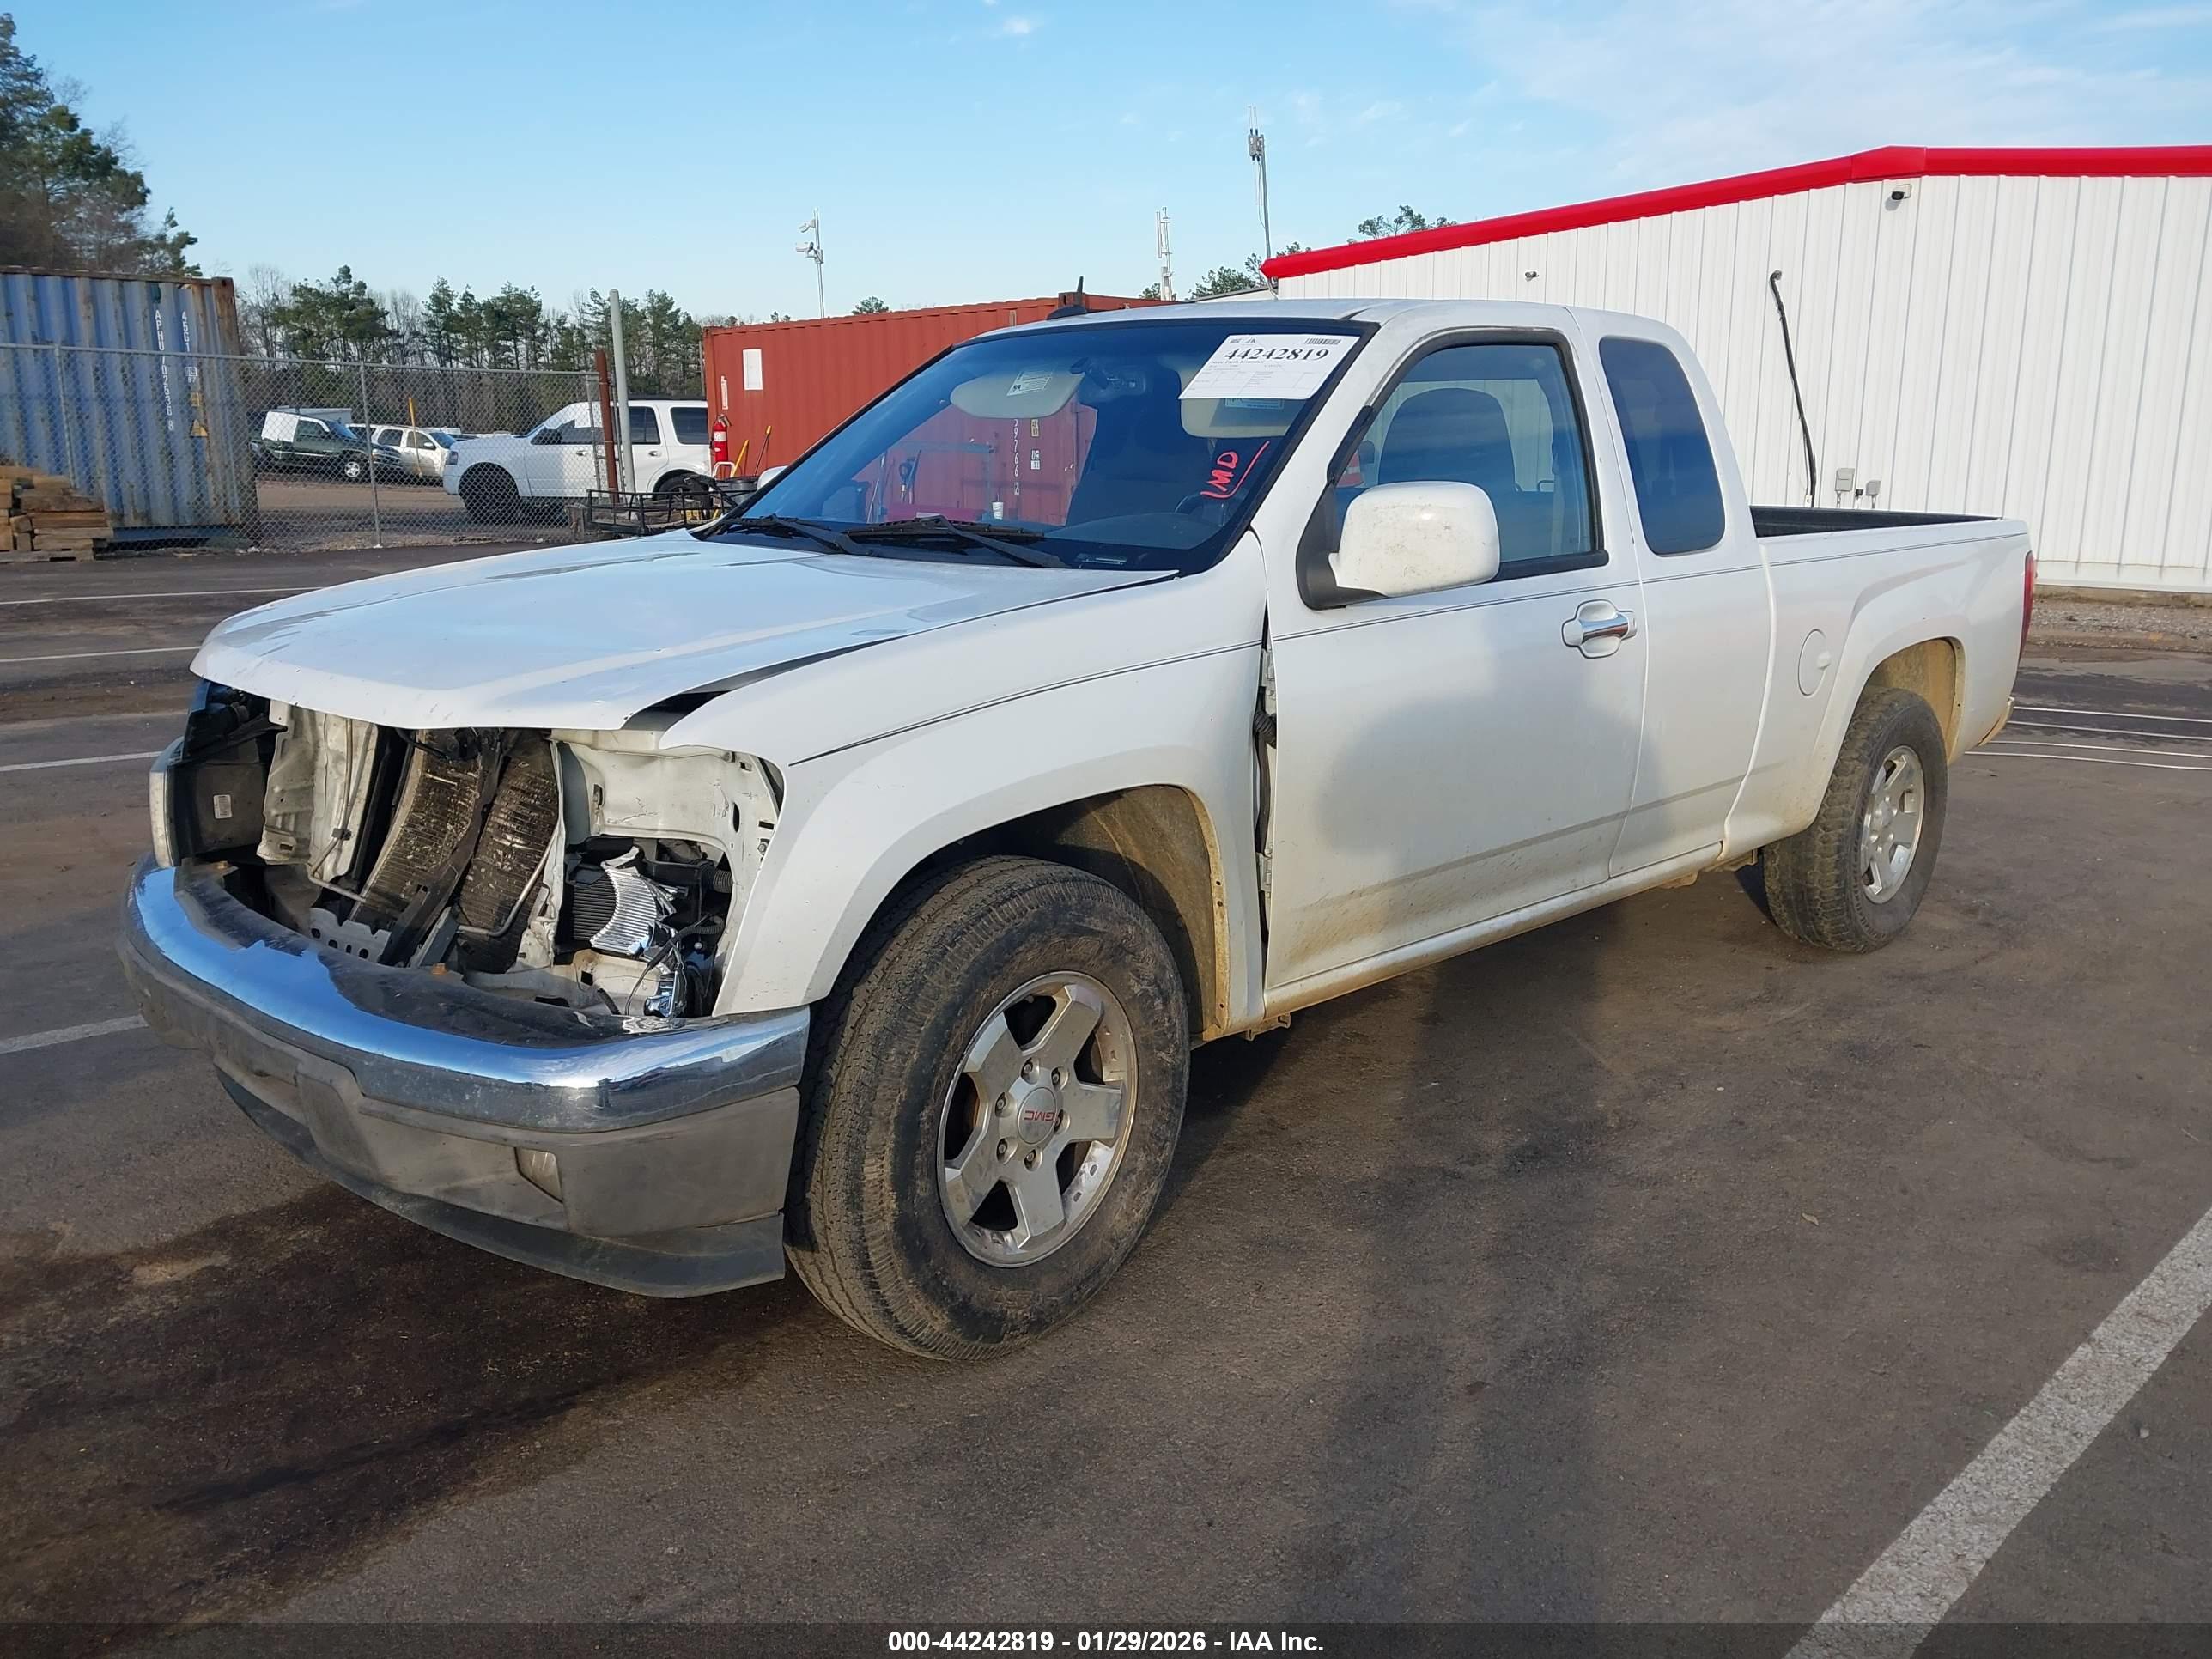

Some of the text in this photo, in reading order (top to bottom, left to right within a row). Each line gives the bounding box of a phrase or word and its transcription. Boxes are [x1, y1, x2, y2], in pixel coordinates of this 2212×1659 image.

[155, 309, 165, 351] APHU
[1224, 348, 1329, 361] 44242819
[1023, 1110, 1054, 1121] GMC
